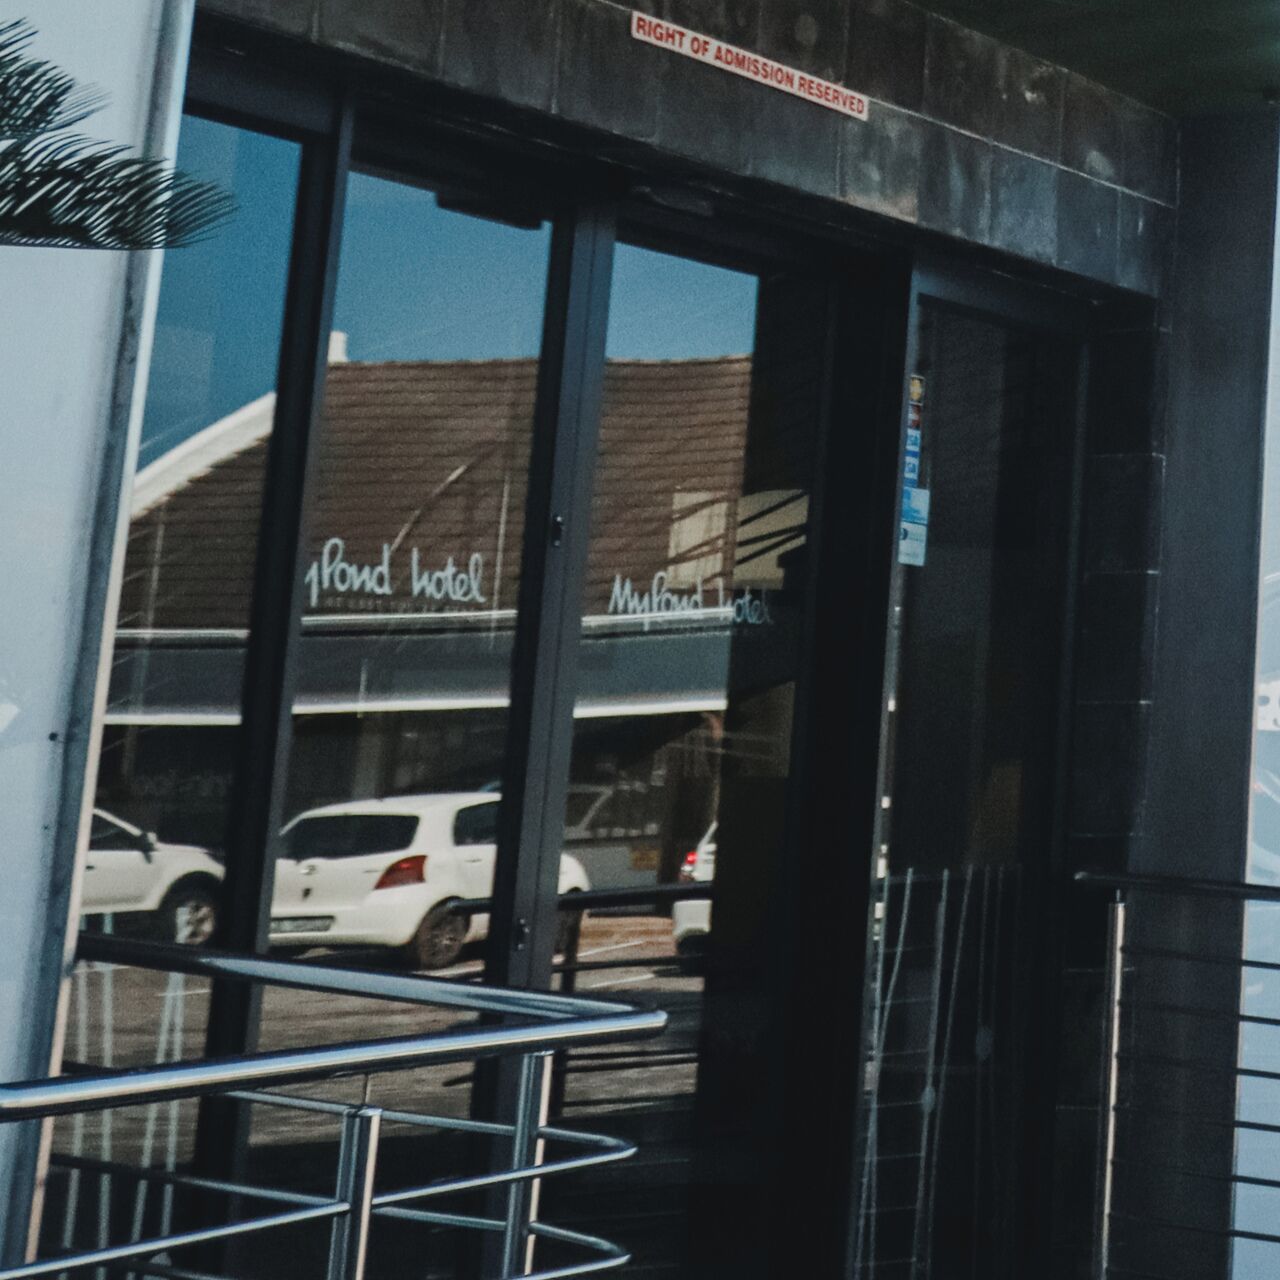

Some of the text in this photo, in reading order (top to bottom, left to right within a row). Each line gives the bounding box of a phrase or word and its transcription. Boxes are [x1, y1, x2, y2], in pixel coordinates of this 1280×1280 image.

[636, 16, 865, 115] RIGHT OF ADMISSION RESERVED
[411, 546, 487, 603] hotel
